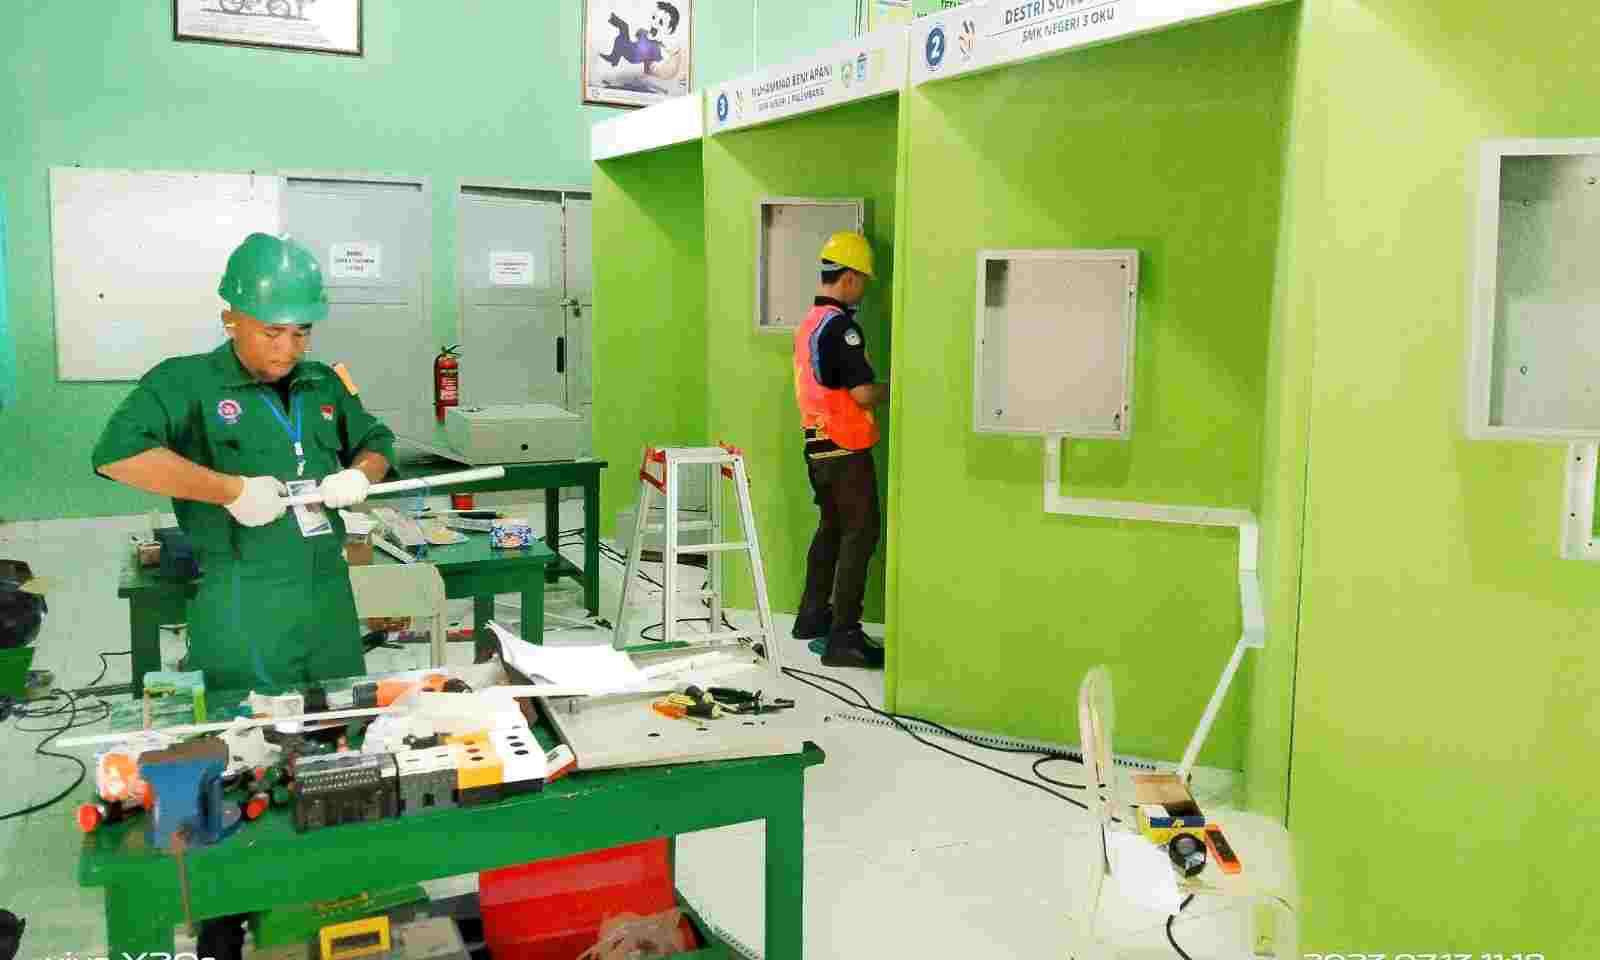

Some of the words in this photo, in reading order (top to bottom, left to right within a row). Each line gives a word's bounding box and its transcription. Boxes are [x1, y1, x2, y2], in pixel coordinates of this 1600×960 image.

[1005, 0, 1044, 24] DESTRI
[1022, 27, 1042, 42] SMK
[1044, 18, 1080, 36] NEGERI
[1091, 8, 1114, 23] OKU
